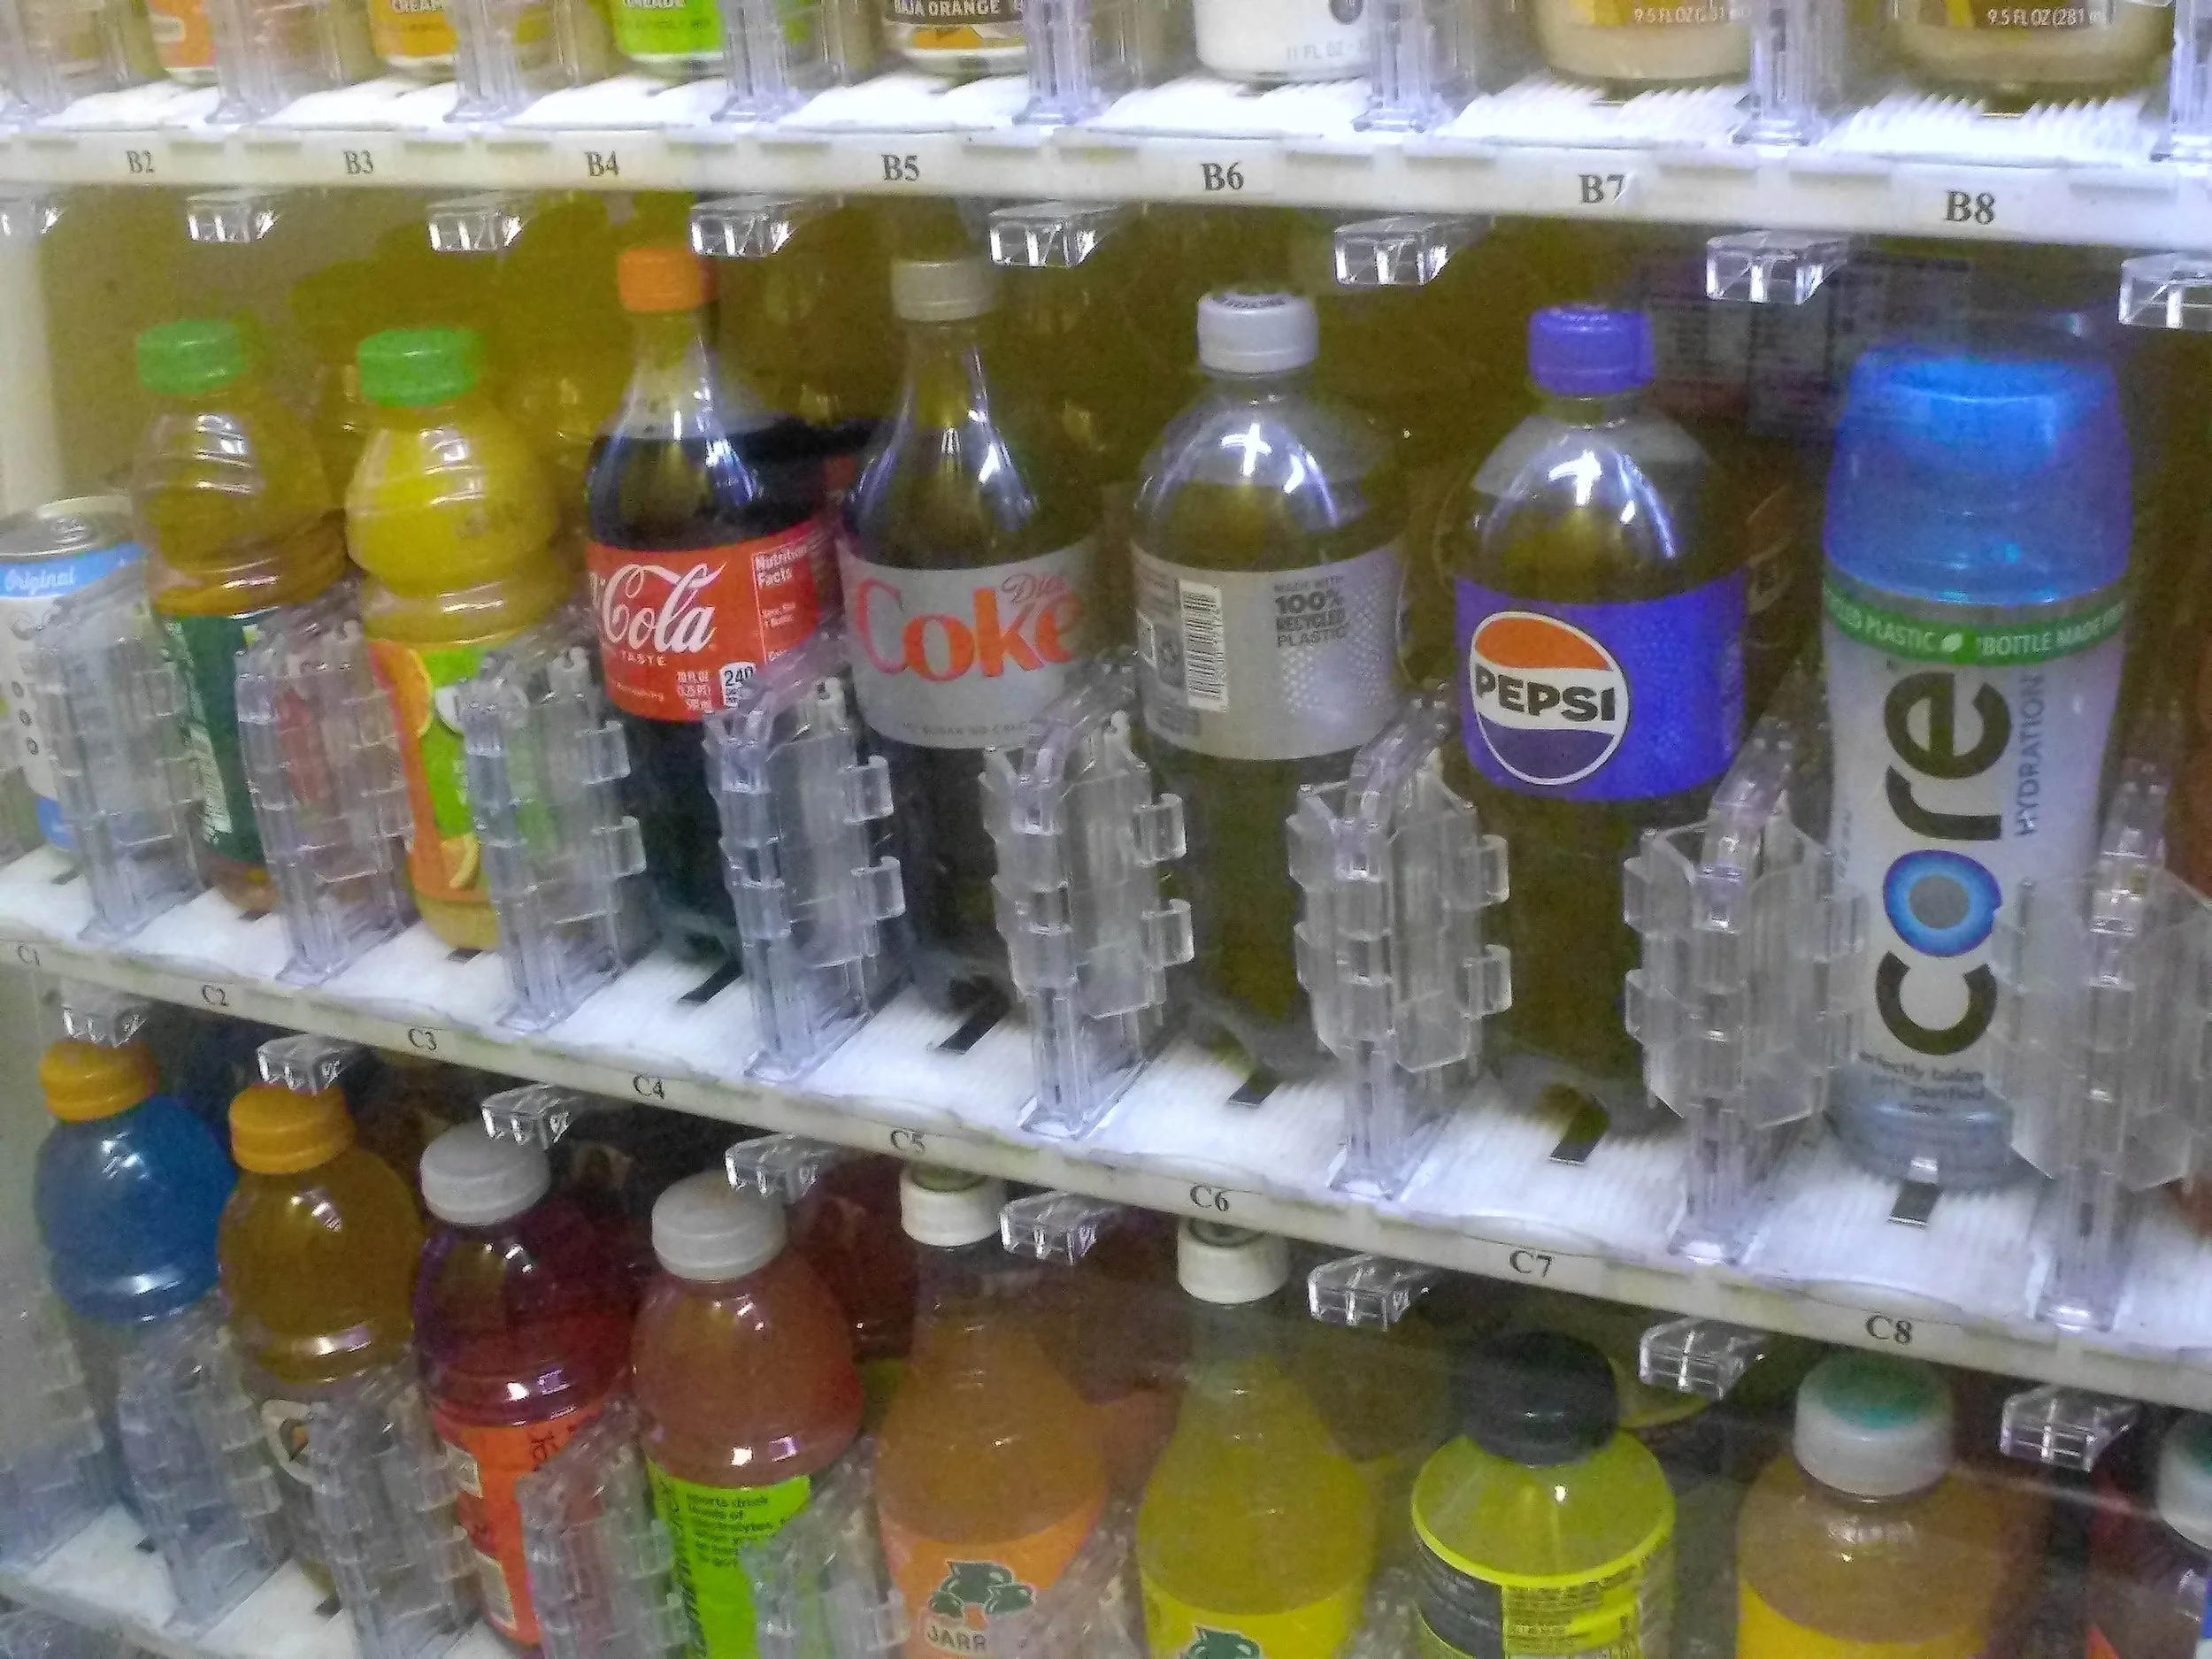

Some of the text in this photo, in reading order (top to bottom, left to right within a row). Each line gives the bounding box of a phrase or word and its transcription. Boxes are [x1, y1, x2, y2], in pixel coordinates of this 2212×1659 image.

[928, 0, 1001, 16] ORANGE
[127, 150, 155, 174] B2
[343, 150, 375, 175] B3
[586, 151, 619, 177] B4
[882, 154, 920, 182] B5
[1202, 162, 1245, 192] B6
[1579, 174, 1625, 205] B7
[1946, 190, 1997, 226] B8
[757, 568, 794, 589] Facts
[1274, 588, 1345, 615] 100%
[855, 577, 1083, 682] Coke
[1277, 621, 1351, 649] PLASTIC
[1865, 615, 1937, 652] PLASTIC
[1981, 631, 2052, 657] BOTTLE
[620, 649, 666, 666] TASTE
[724, 665, 754, 687] 240
[1475, 664, 1617, 723] PEPSI
[2014, 674, 2046, 837] HYDRATION
[1875, 671, 2012, 1056] core
[202, 983, 228, 1008] C2
[408, 1027, 437, 1051] C3
[633, 1073, 665, 1099] C4
[889, 1128, 926, 1152] C5
[1189, 1182, 1231, 1212] C6
[1509, 1248, 1553, 1278] C7
[1864, 1313, 1912, 1345] C8
